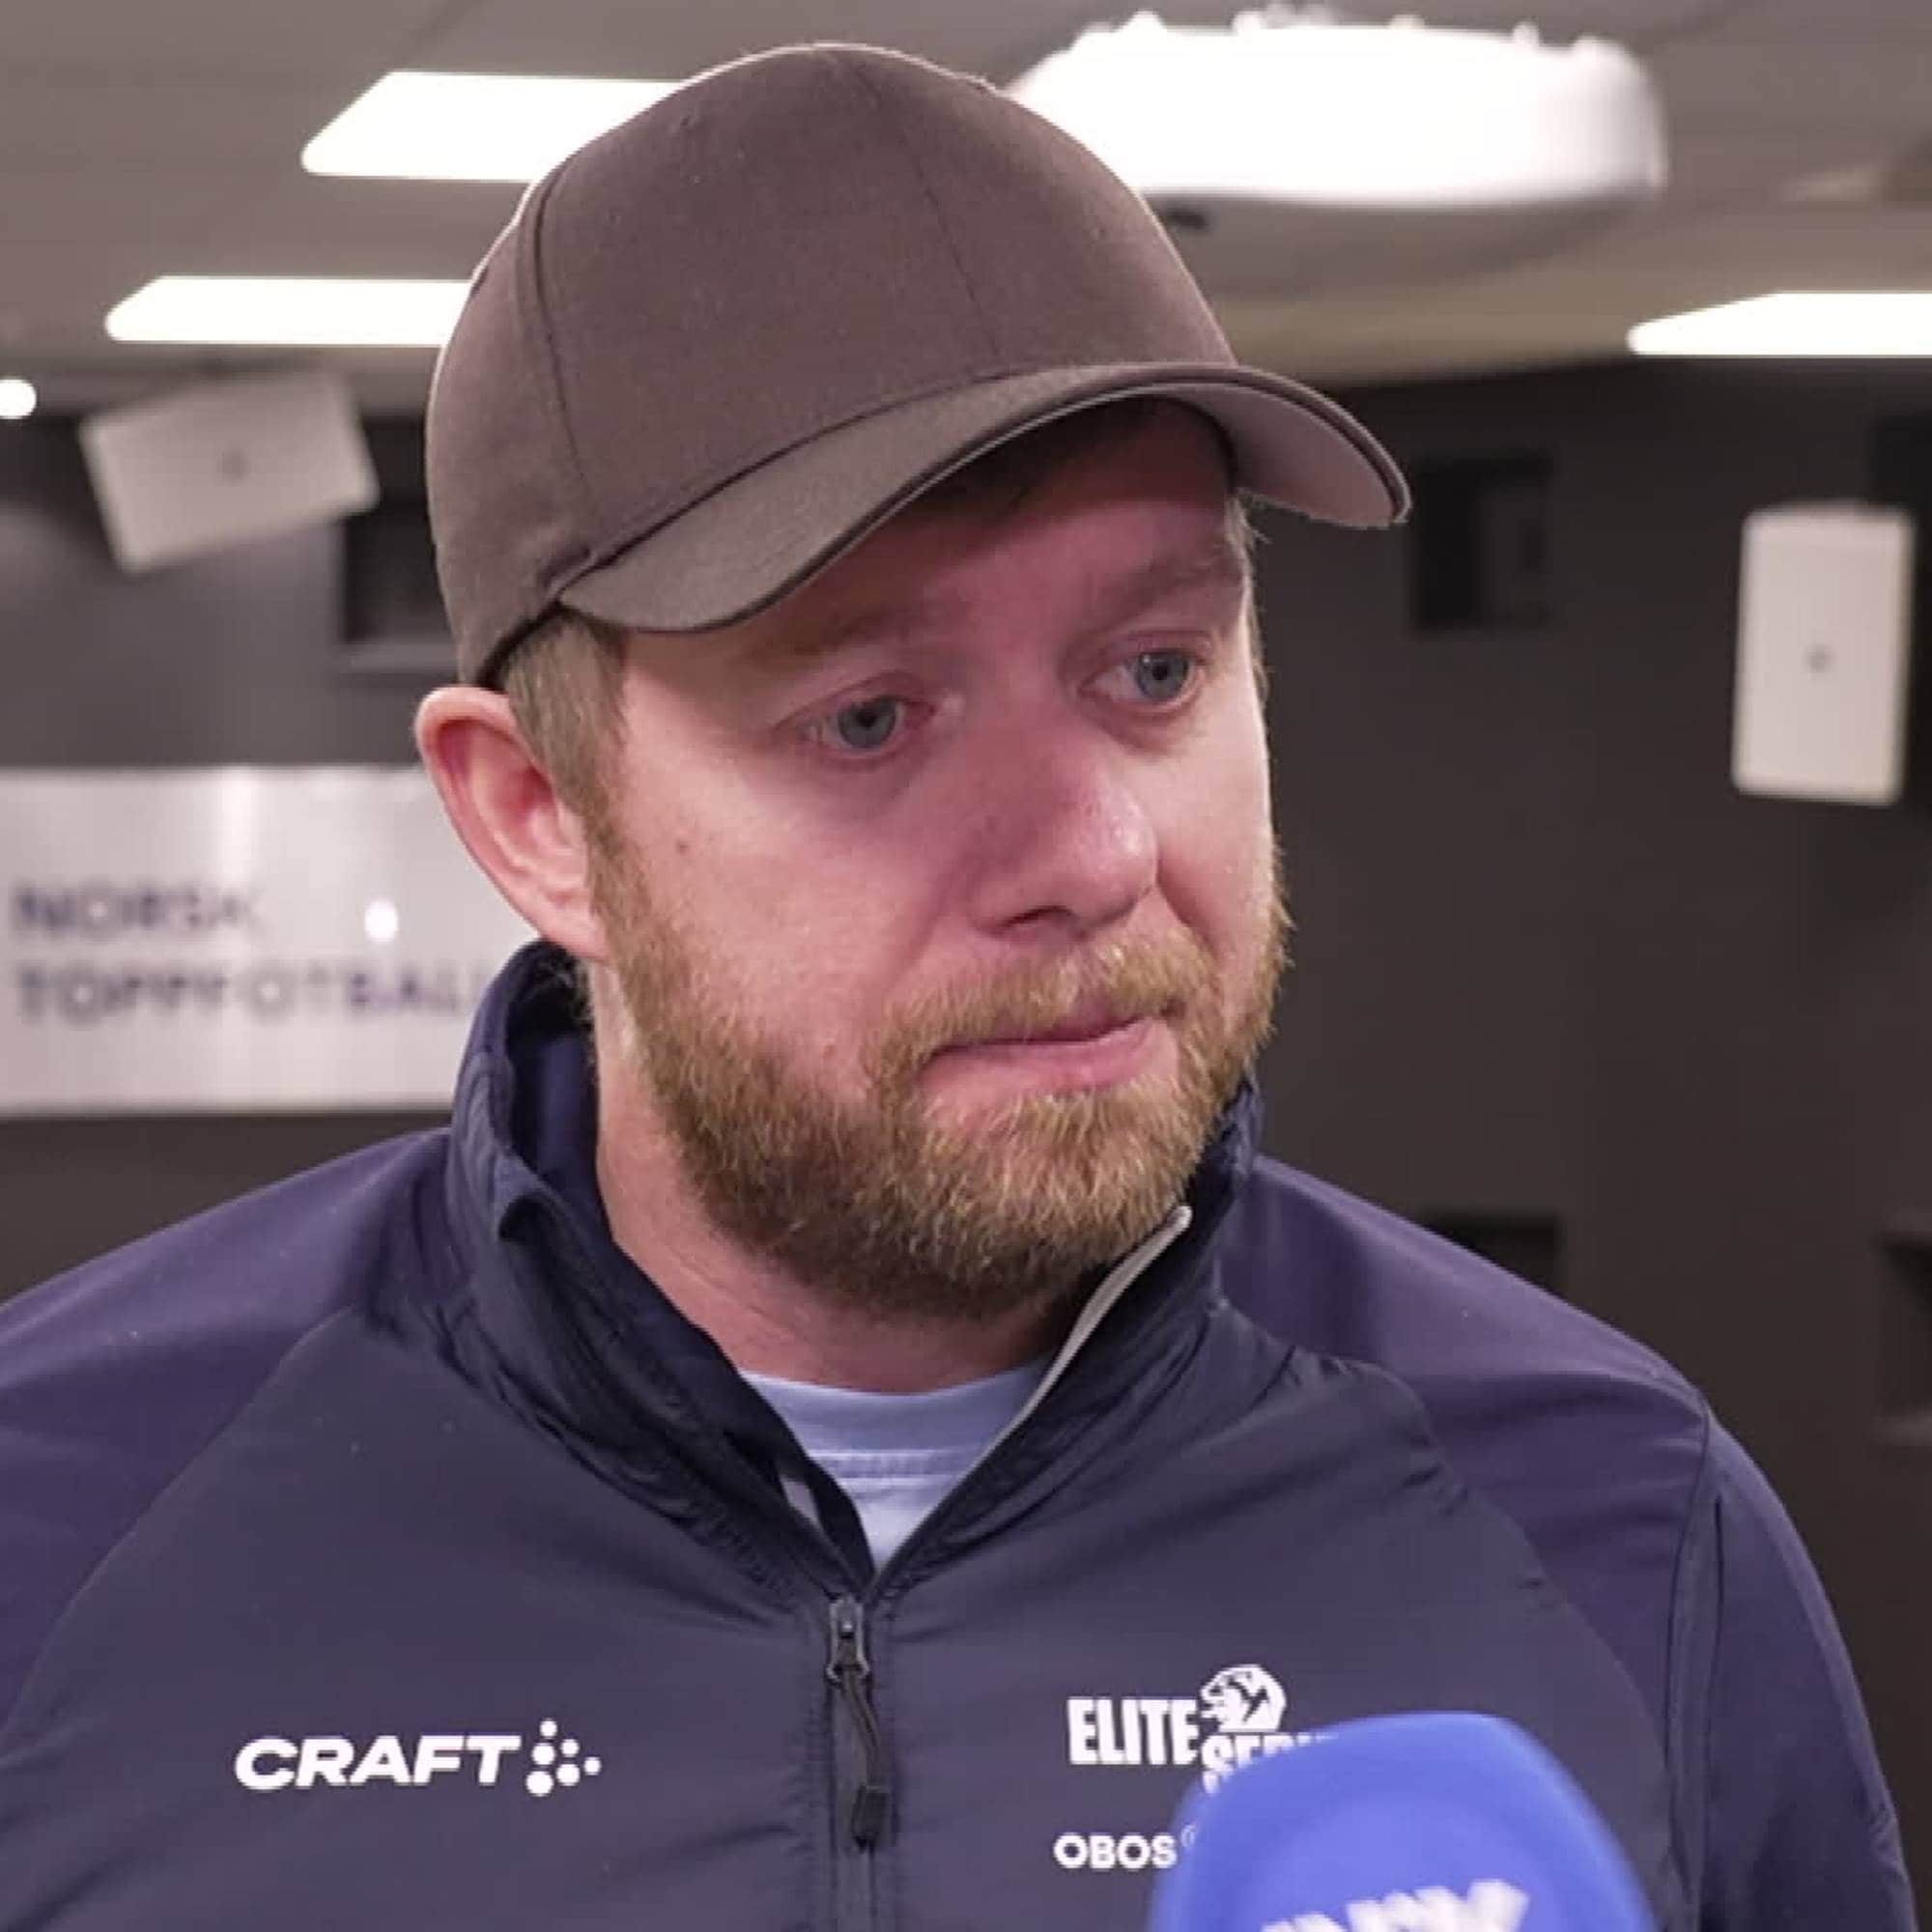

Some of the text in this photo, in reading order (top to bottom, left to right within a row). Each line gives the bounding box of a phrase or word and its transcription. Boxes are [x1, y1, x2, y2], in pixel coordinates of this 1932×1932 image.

[1067, 1696, 1200, 1765] ELITE
[235, 1734, 523, 1791] CRAFT
[1053, 1833, 1178, 1870] OBOS
